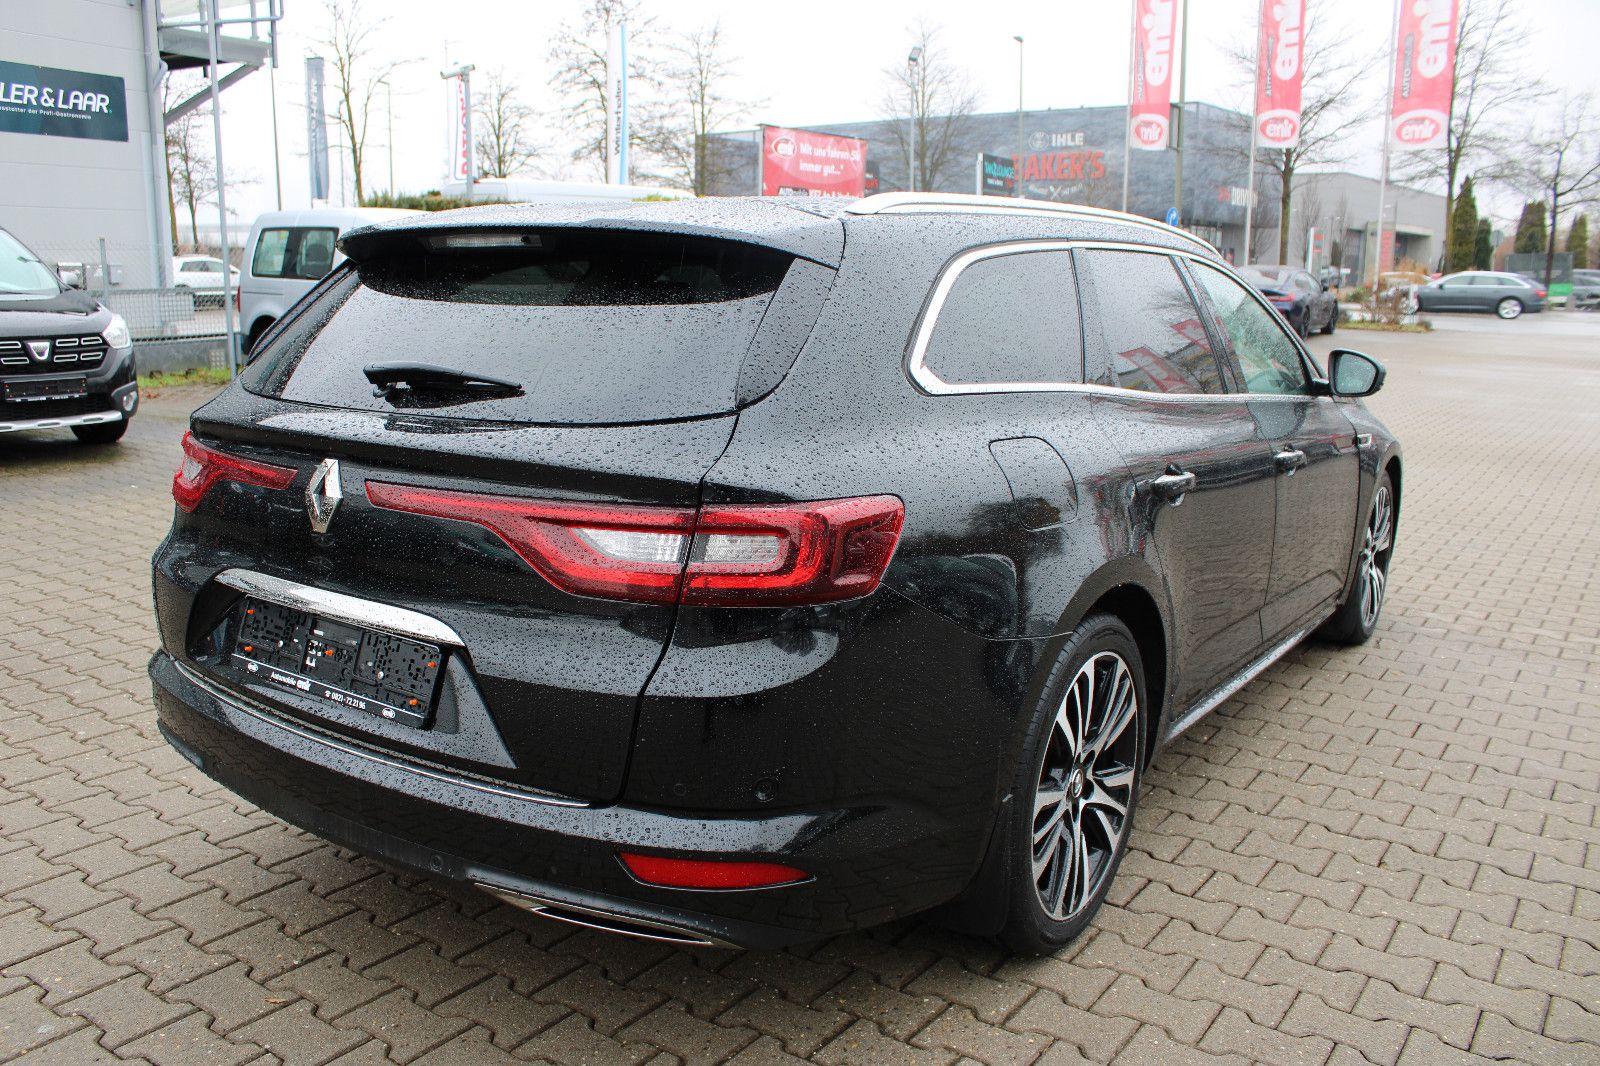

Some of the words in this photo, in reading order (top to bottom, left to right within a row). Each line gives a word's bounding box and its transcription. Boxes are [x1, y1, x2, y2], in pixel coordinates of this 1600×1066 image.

[1273, 0, 1301, 80] emi
[1413, 0, 1450, 78] emi
[40, 87, 55, 108] &
[1051, 132, 1084, 146] IHLE
[1401, 119, 1436, 140] emir
[800, 143, 812, 155] Mit
[814, 146, 827, 157] uns
[828, 145, 849, 160] fahren
[800, 162, 822, 173] immer
